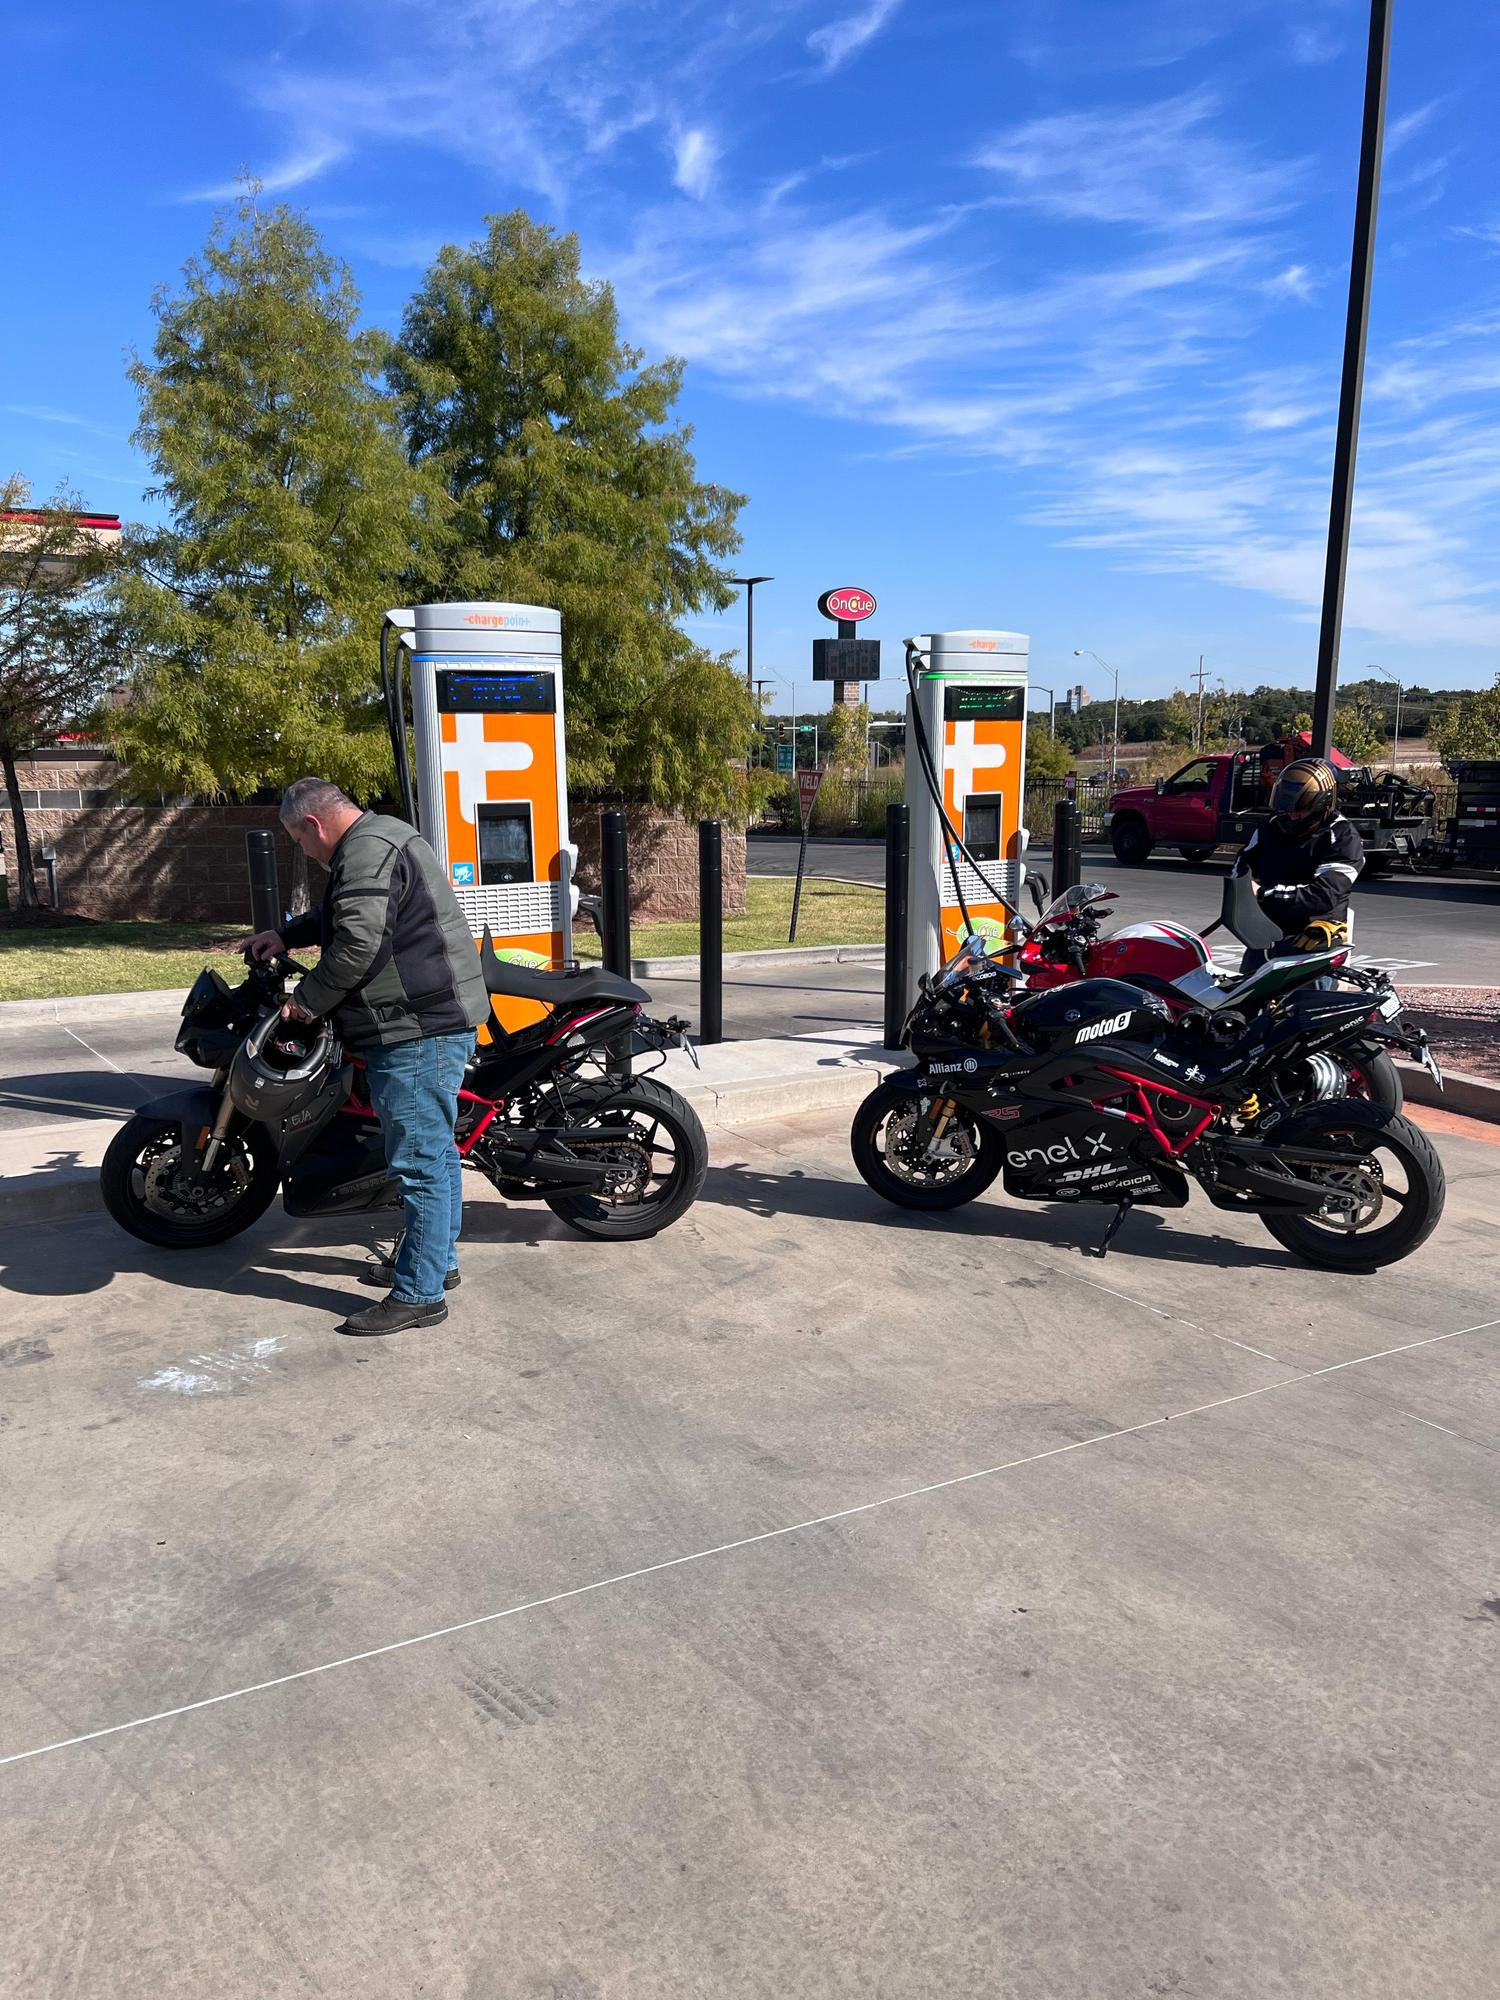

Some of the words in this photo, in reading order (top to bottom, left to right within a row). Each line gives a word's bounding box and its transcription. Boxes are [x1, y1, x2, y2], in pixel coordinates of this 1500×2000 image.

[830, 596, 873, 613] OnCue
[800, 775, 819, 789] YIELD
[929, 1063, 962, 1074] Allianz
[1007, 1136, 1080, 1168] enel
[1062, 1163, 1118, 1182] DHL
